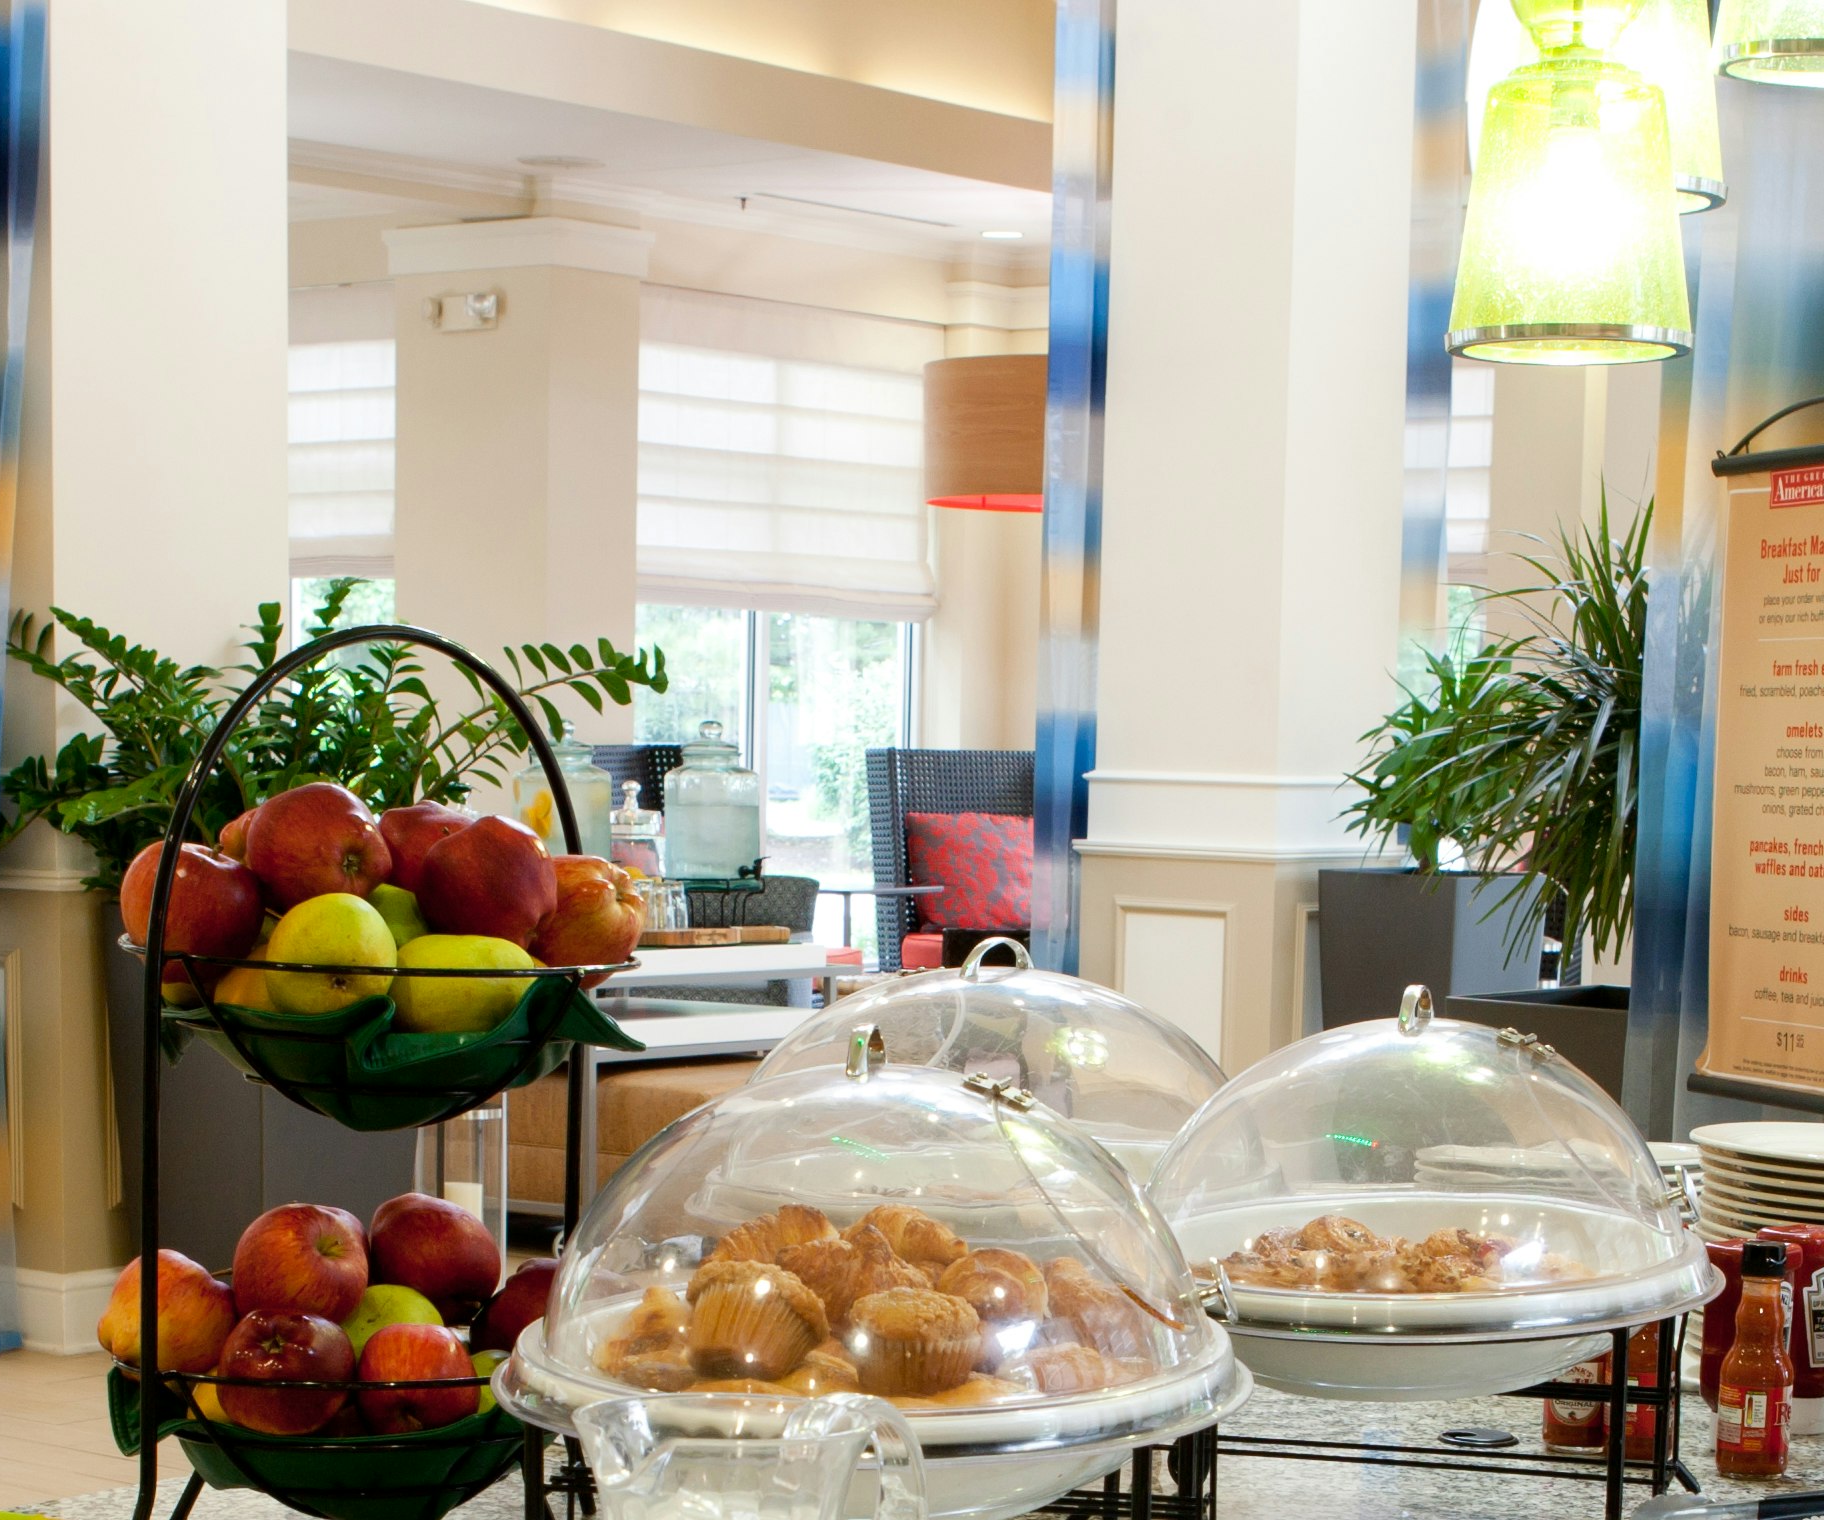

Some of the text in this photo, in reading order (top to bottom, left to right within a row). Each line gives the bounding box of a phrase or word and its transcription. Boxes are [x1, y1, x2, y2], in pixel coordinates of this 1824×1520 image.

[1785, 474, 1800, 483] THE
[1761, 537, 1807, 559] Breakfast
[1783, 564, 1803, 584] Just
[1807, 562, 1820, 582] for
[1764, 595, 1780, 607] place
[1782, 596, 1795, 606] your
[1797, 594, 1813, 603] order
[1759, 615, 1765, 624] or
[1767, 613, 1783, 625] enjoy
[1785, 614, 1795, 623] our
[1797, 611, 1809, 622] rich
[1773, 660, 1792, 676] farm
[1795, 659, 1818, 676] fresh
[1740, 685, 1757, 698] fried,
[1760, 684, 1796, 698] scrambled,
[1786, 722, 1823, 738] omelets
[1776, 747, 1802, 759] choose
[1764, 765, 1786, 778] bacon,
[1789, 766, 1807, 778] ham,
[1734, 783, 1775, 796] mushrooms,
[1778, 785, 1799, 798] green
[1762, 804, 1786, 816] onions,
[1789, 804, 1813, 818] grated
[1750, 837, 1790, 856] pancakes,
[1794, 838, 1823, 856] french
[1755, 859, 1786, 876] waffles
[1789, 860, 1806, 877] and
[1784, 905, 1809, 922] sides
[1729, 924, 1750, 938] bacon,
[1752, 928, 1780, 942] sausage
[1783, 930, 1796, 942] and
[1780, 965, 1808, 984] drinks
[1754, 987, 1778, 1003] coffee,
[1781, 991, 1793, 1003] tea
[1796, 993, 1809, 1005] and
[1555, 1399, 1593, 1408] ORIGINAL
